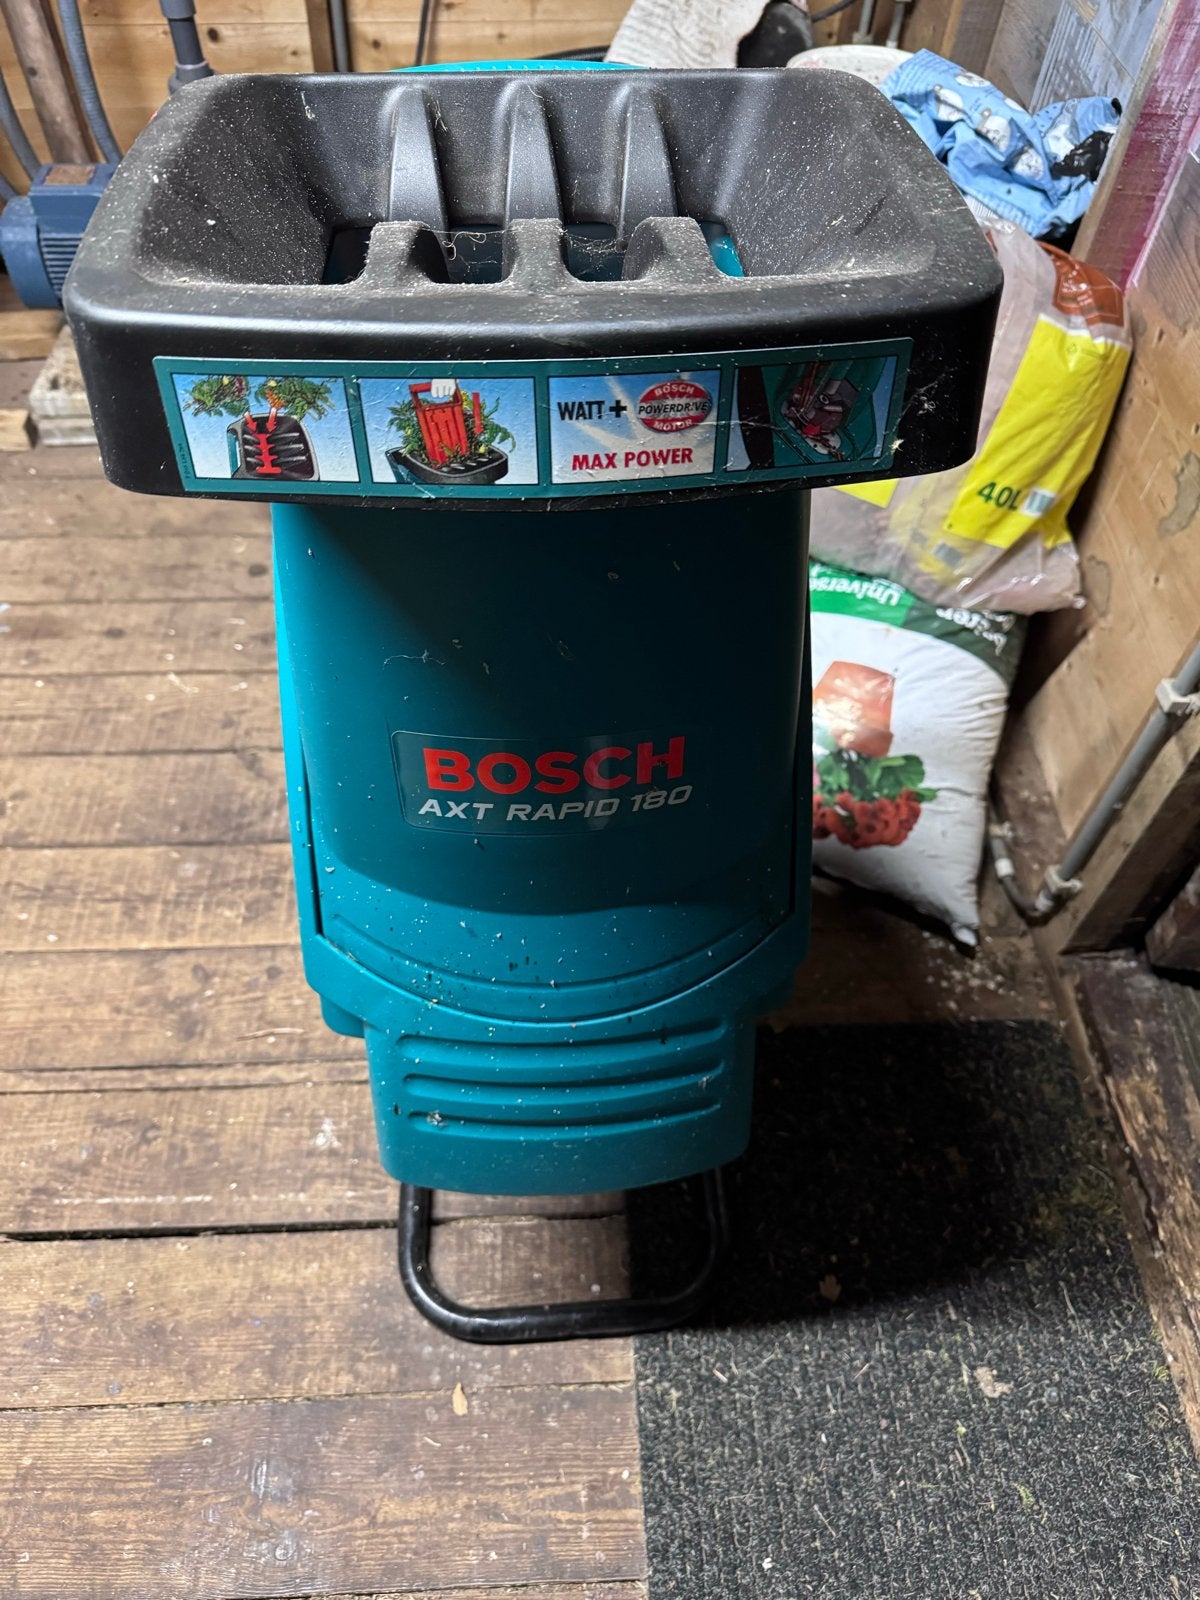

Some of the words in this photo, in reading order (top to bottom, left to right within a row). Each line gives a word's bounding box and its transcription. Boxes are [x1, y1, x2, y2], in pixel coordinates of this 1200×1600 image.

[655, 384, 695, 396] BOSCH
[557, 400, 605, 421] WATT
[638, 400, 710, 415] POWERDRIVE
[652, 418, 693, 431] MOTOR
[572, 452, 618, 471] MAX
[624, 448, 694, 468] POWER
[977, 482, 1021, 511] 40L
[423, 736, 685, 795] BOSCH
[418, 798, 494, 820] AXT
[506, 798, 621, 821] RAPID
[631, 785, 694, 812] 180
